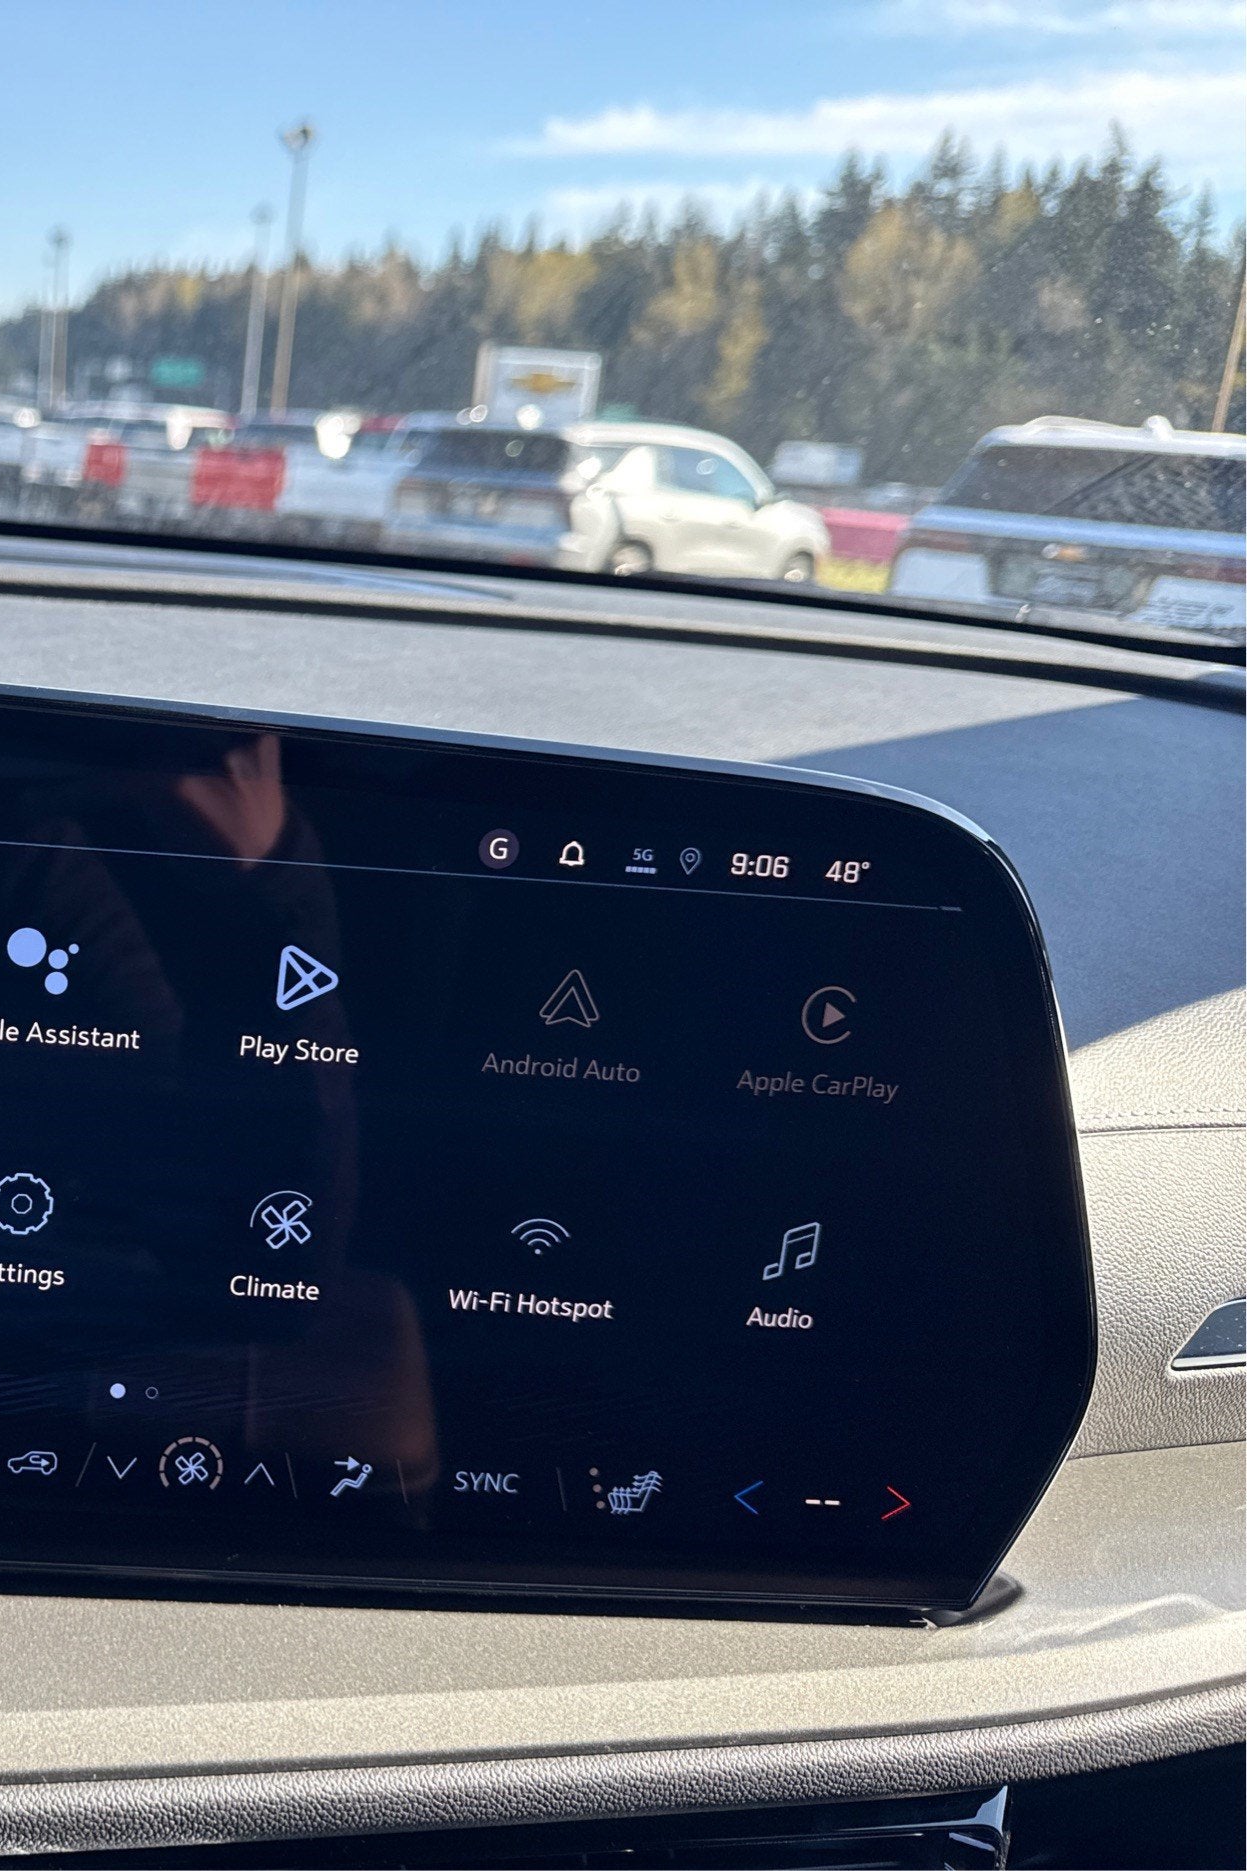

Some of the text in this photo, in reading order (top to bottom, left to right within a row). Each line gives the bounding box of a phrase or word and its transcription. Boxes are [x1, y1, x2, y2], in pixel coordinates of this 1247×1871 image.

[489, 837, 509, 860] G
[632, 848, 654, 862] 5G
[730, 852, 790, 878] 9:06
[825, 860, 870, 884] 48°
[25, 1021, 141, 1050] Assistant
[239, 1035, 359, 1065] Play Store
[481, 1052, 641, 1083] Android Auto
[735, 1069, 900, 1105] Apple CarPlay
[230, 1275, 320, 1301] Climate
[449, 1288, 613, 1323] Wi-Fi Hotspot
[745, 1306, 813, 1329] Audio
[453, 1470, 519, 1493] SYNC
